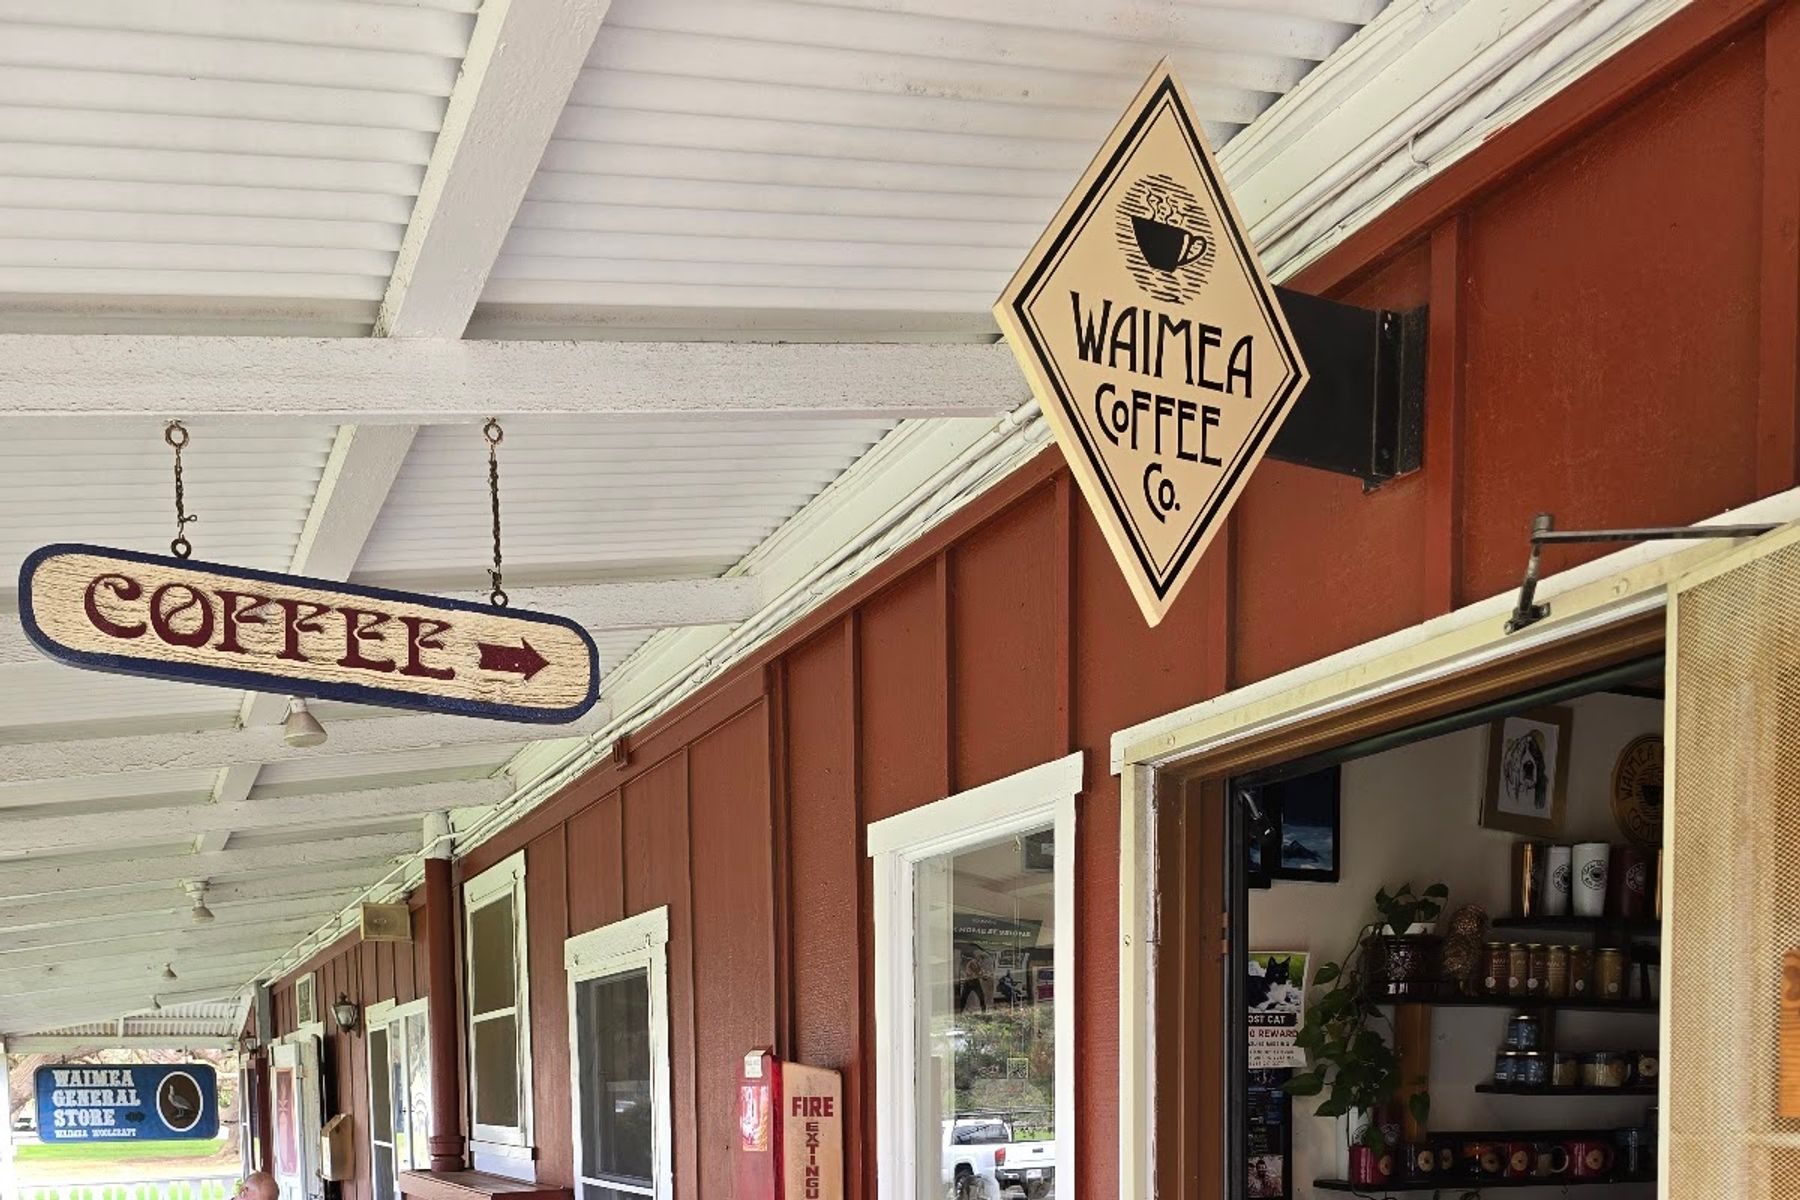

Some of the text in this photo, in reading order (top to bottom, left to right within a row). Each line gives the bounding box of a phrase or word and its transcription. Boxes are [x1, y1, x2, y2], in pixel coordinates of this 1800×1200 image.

[1069, 290, 1254, 398] WAIMEA
[1095, 382, 1222, 467] COFFEE
[84, 573, 456, 680] COFFEE
[1248, 1015, 1286, 1024] OST CAT
[1258, 1029, 1298, 1038] REWARD
[52, 1069, 135, 1087] WAIMEA
[52, 1089, 141, 1107] GENERAL
[792, 1096, 834, 1117] FIRE
[53, 1109, 115, 1127] STORE
[54, 1128, 137, 1138] WAIMEA WOOLCRAFT
